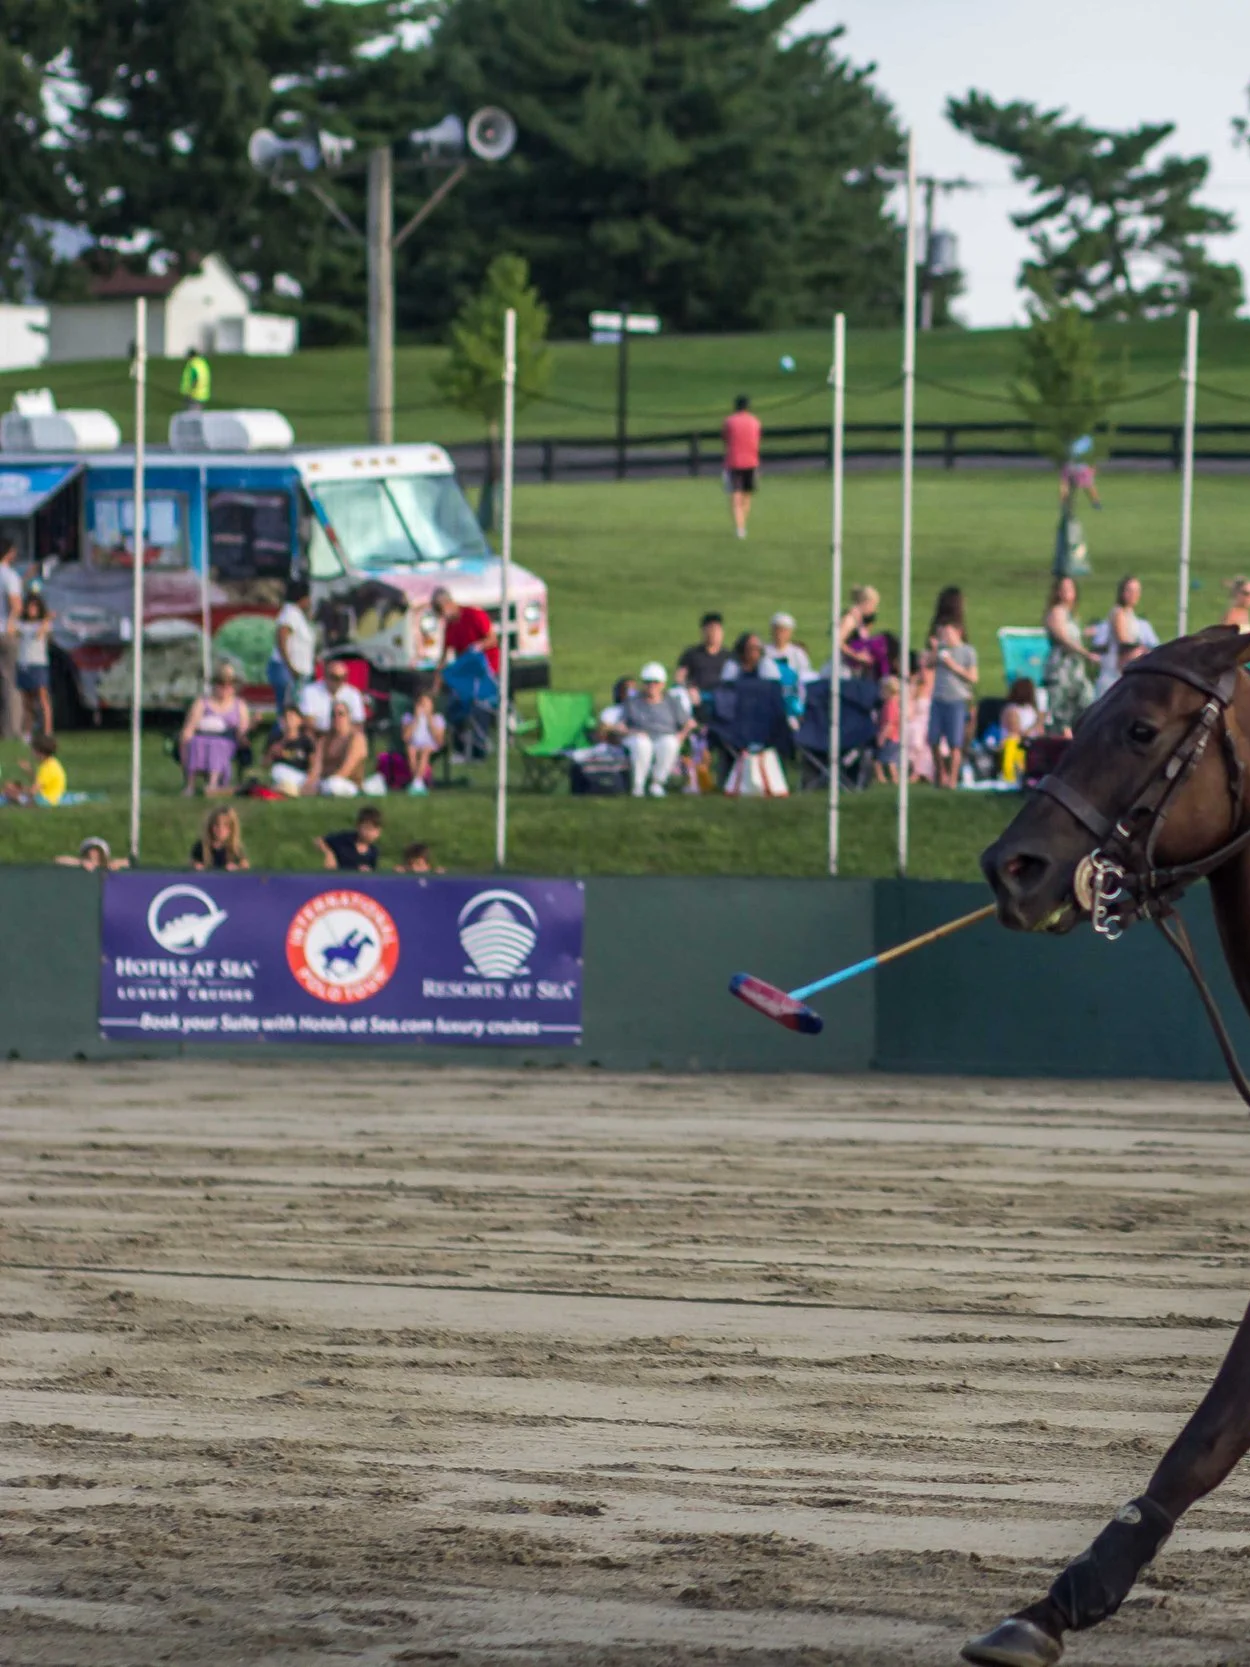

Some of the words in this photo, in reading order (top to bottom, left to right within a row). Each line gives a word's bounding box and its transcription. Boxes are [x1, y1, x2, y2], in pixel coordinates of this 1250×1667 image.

[115, 956, 190, 977] HOTELS
[192, 959, 217, 977] AT
[116, 986, 178, 1001] LUXURY
[187, 988, 254, 1002] CRUISES
[422, 978, 505, 998] RESORTS
[509, 981, 532, 999] AT
[140, 1011, 180, 1031] Book
[181, 1016, 218, 1035] your
[220, 1013, 259, 1032] Suite
[261, 1015, 297, 1032] with
[299, 1014, 348, 1033] Hotels
[349, 1016, 369, 1033] at
[435, 1016, 486, 1038] luxury
[487, 1017, 541, 1035] cruises
